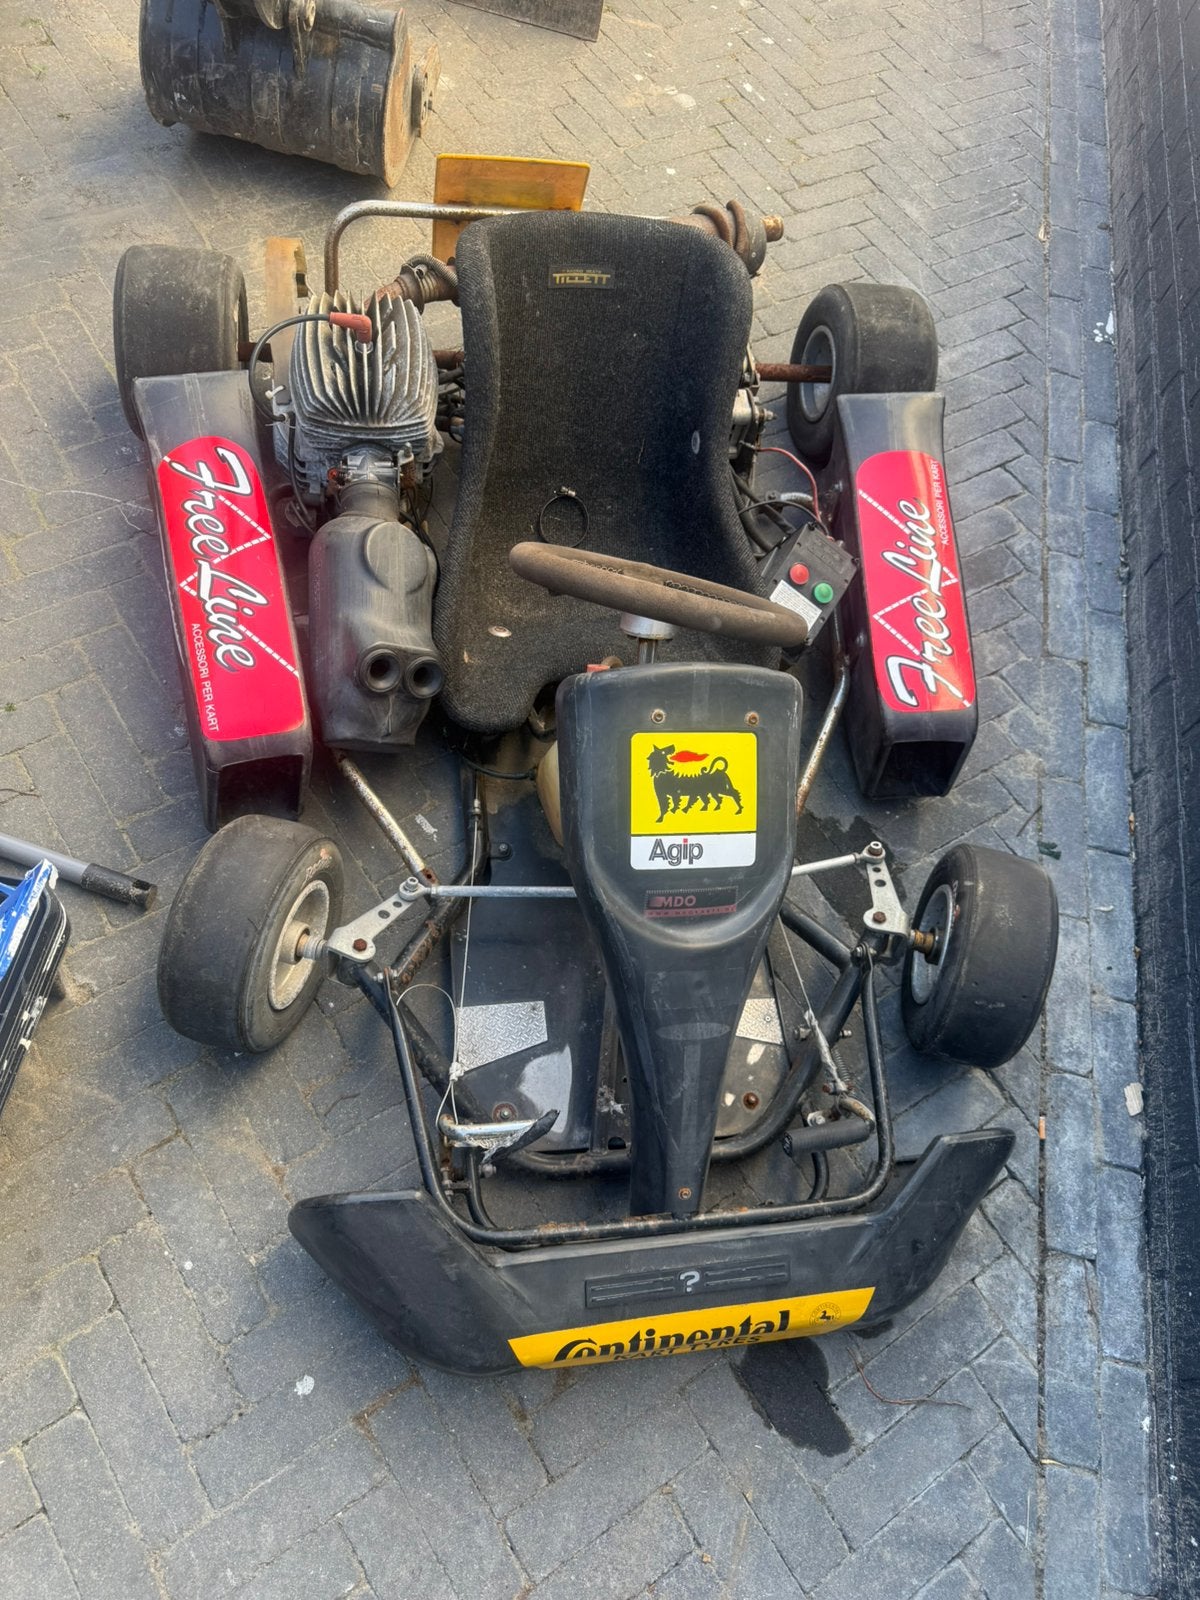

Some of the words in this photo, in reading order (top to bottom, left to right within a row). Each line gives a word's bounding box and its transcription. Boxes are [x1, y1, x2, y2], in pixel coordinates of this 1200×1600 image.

[552, 272, 611, 285] TILLETT
[931, 459, 940, 480] KART
[169, 446, 253, 559] Free
[933, 479, 943, 498] PER
[935, 499, 950, 546] ACCESSORI
[881, 497, 942, 597] Line
[196, 557, 270, 672] Line
[192, 623, 209, 679] ACCESSORI
[885, 596, 964, 707] Free
[202, 681, 213, 702] PER
[205, 703, 219, 732] KART
[648, 837, 704, 866] Agip
[660, 895, 697, 908] MDO
[553, 1309, 791, 1362] Continental
[689, 1335, 761, 1351] TYRES
